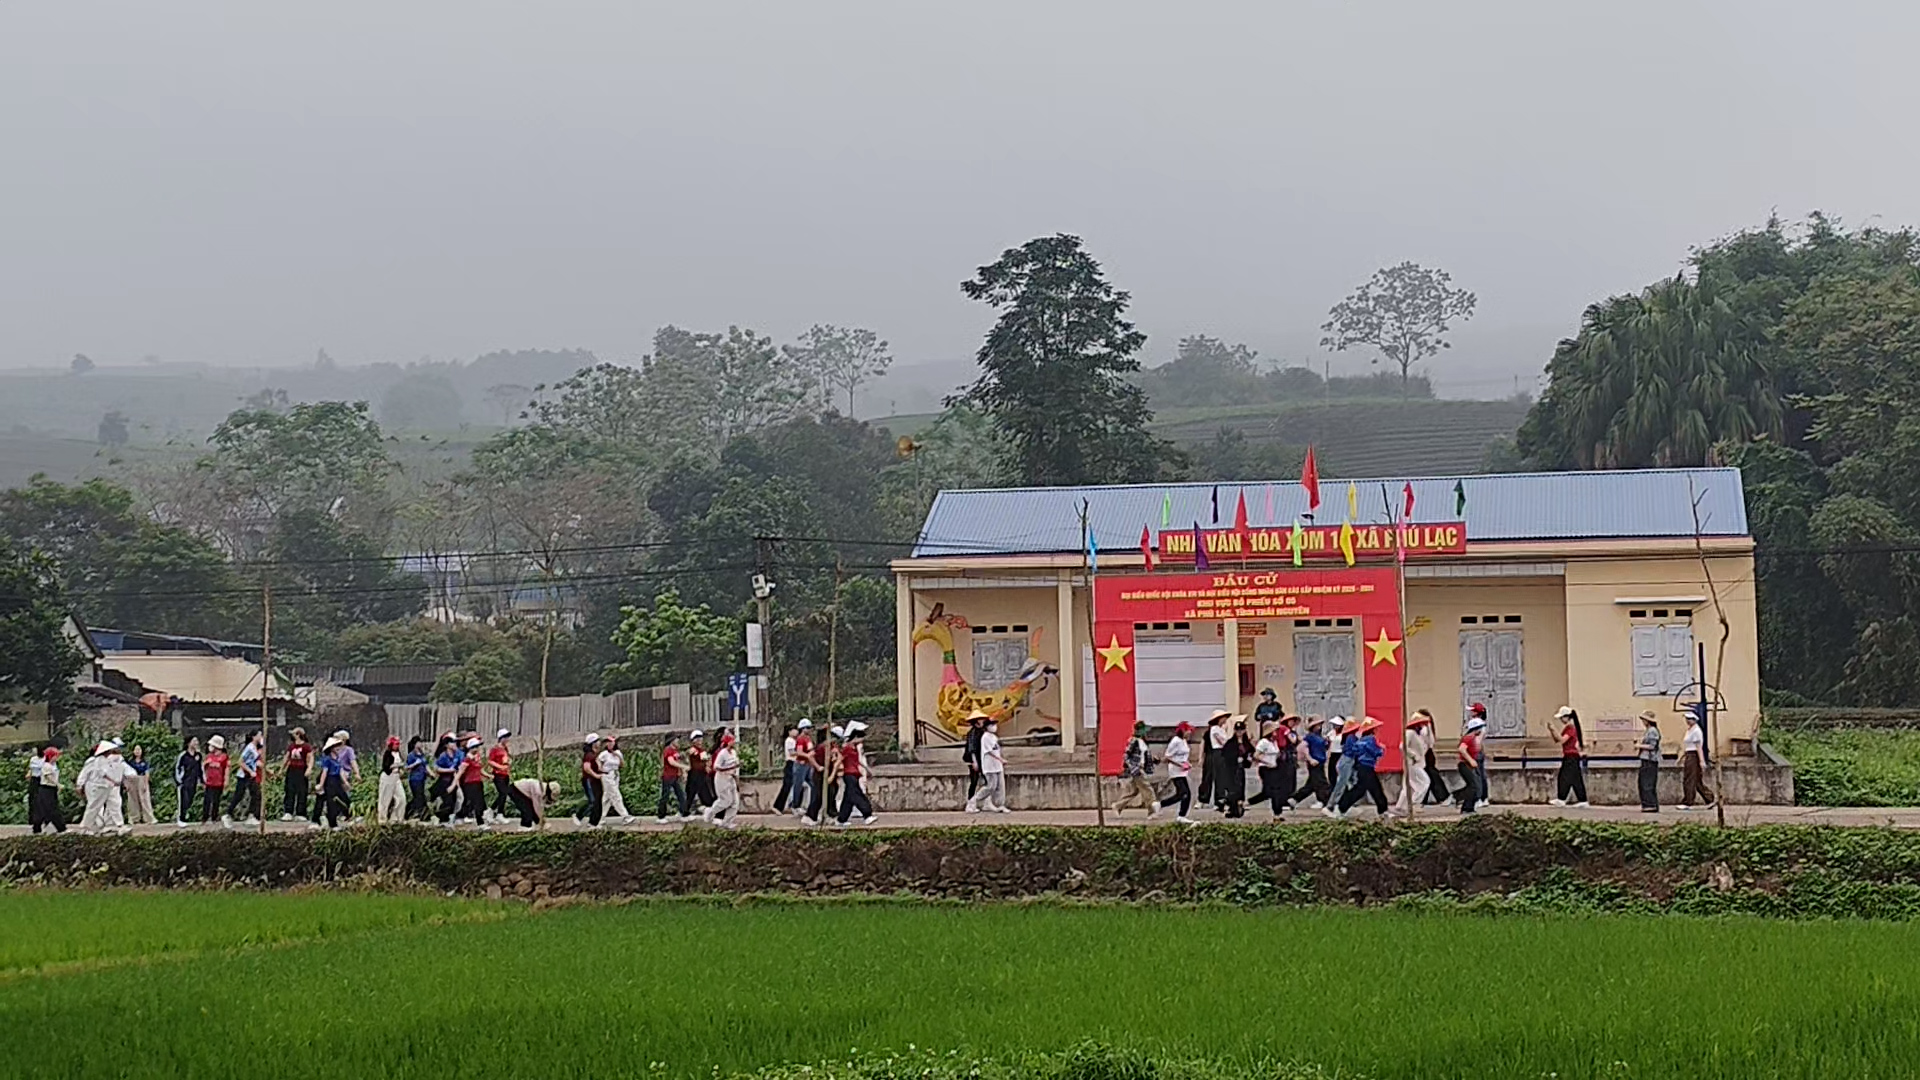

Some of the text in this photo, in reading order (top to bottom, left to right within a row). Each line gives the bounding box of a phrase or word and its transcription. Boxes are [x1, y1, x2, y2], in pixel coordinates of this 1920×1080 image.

[1206, 530, 1242, 553] VĂN
[1356, 526, 1380, 549] XÃ
[1425, 526, 1458, 552] LẠC
[1213, 571, 1279, 587] BẦU CỬ
